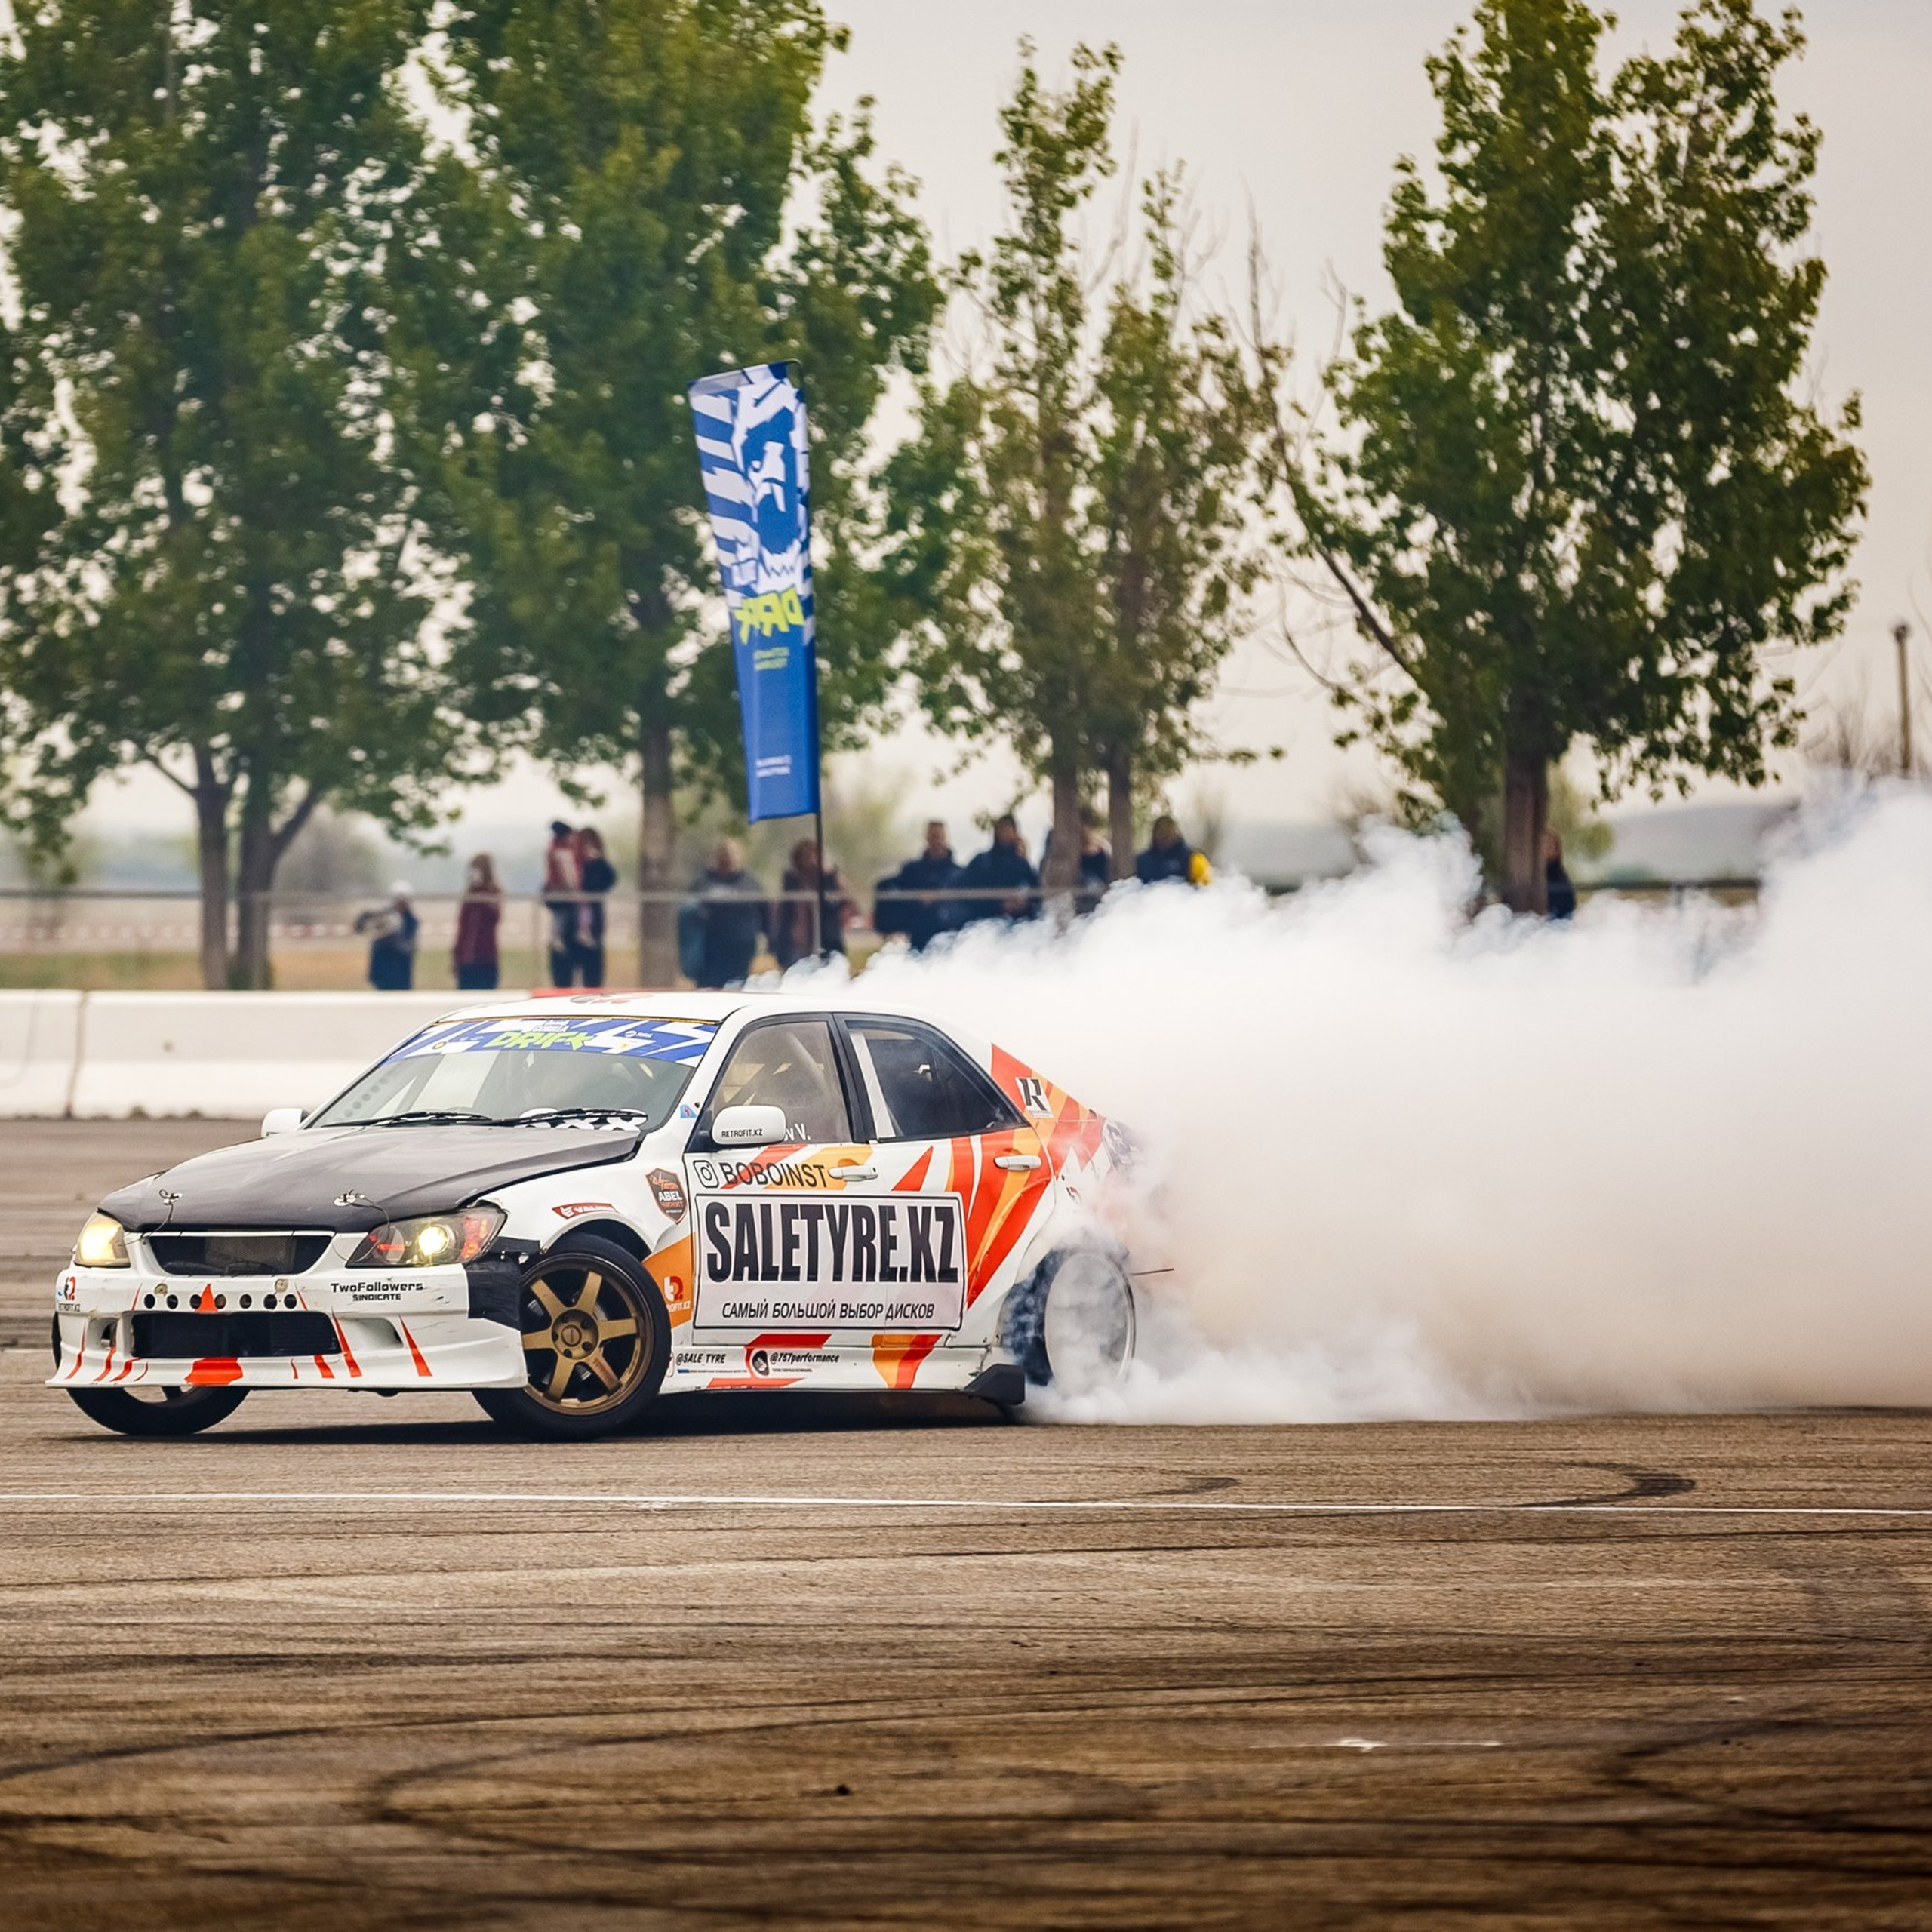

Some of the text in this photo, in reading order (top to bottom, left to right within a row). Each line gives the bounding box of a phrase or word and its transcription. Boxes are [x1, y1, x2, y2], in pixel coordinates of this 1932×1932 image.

[484, 1031, 595, 1051] DRIFT
[721, 1128, 763, 1138] RETROFIT.KZ
[718, 1162, 827, 1188] BOBOINST
[658, 1191, 683, 1201] ABEL
[705, 1201, 959, 1283] SALETYRE.KZ
[331, 1281, 424, 1293] TwoFollowers
[352, 1293, 401, 1301] SINDICATE
[722, 1298, 935, 1320] САМЫЙ БОЛЬШОЙ ВЫБОР ДИСКОВ
